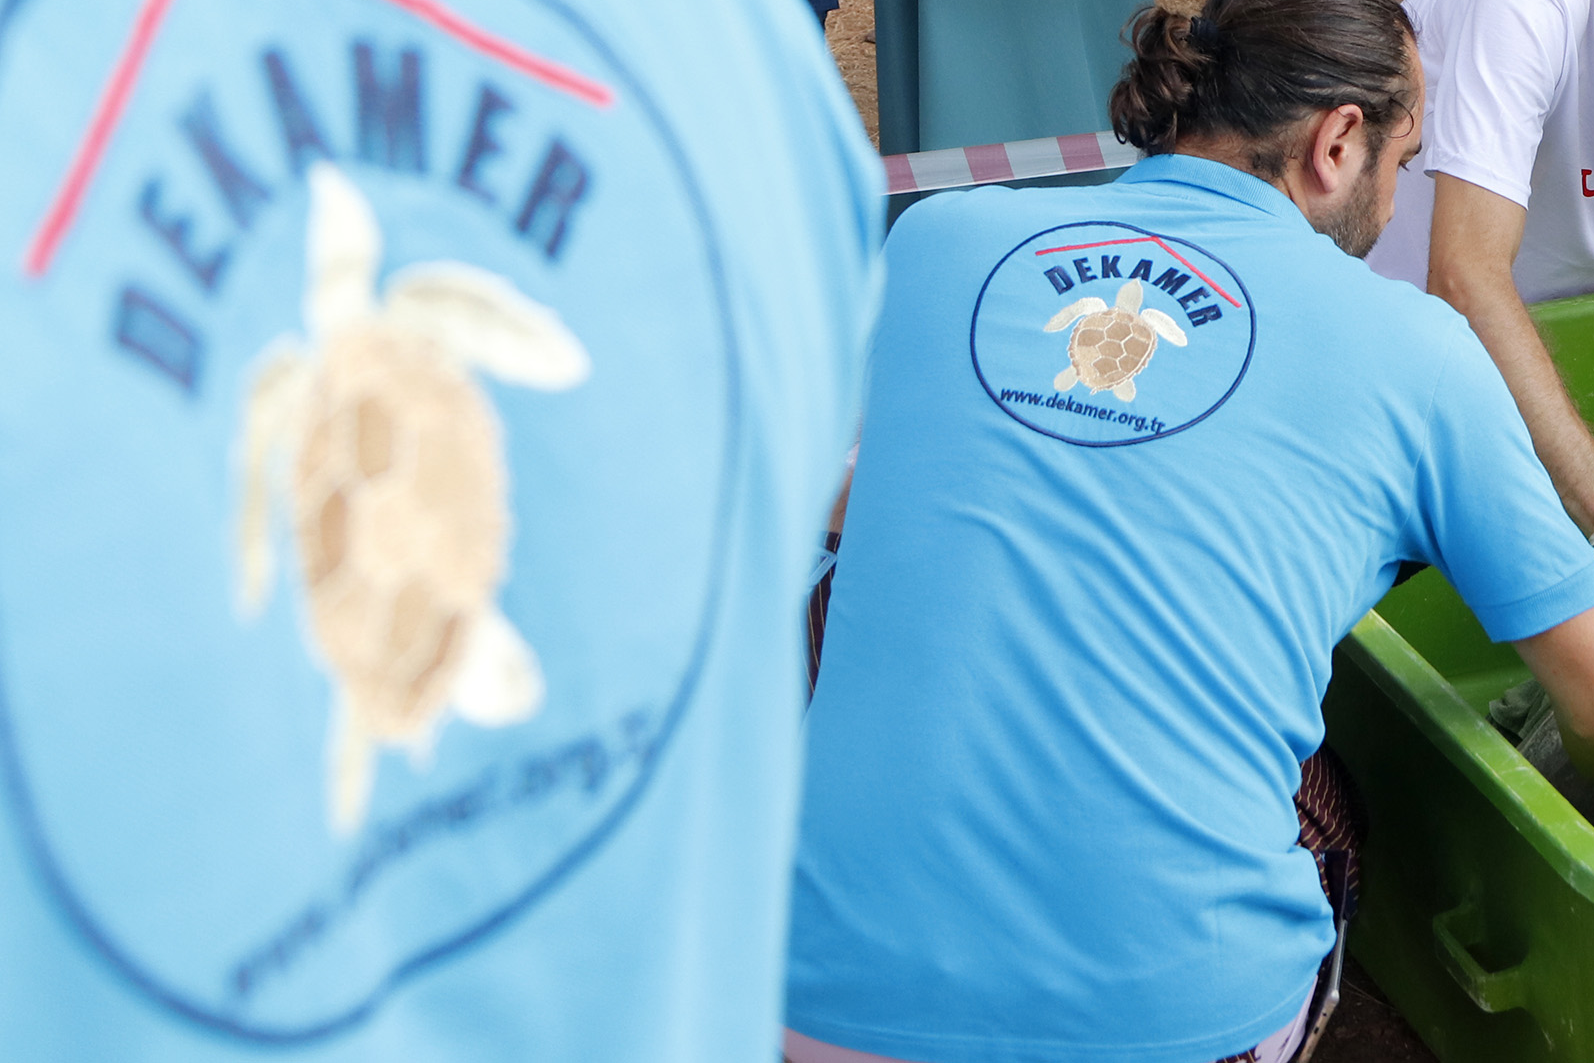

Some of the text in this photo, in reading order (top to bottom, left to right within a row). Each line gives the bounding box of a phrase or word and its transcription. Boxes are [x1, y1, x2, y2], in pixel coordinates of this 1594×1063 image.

[110, 32, 592, 403] DEKAMER
[1043, 254, 1223, 328] DEKAMER
[1000, 388, 1166, 435] www.dekamer.org.tr
